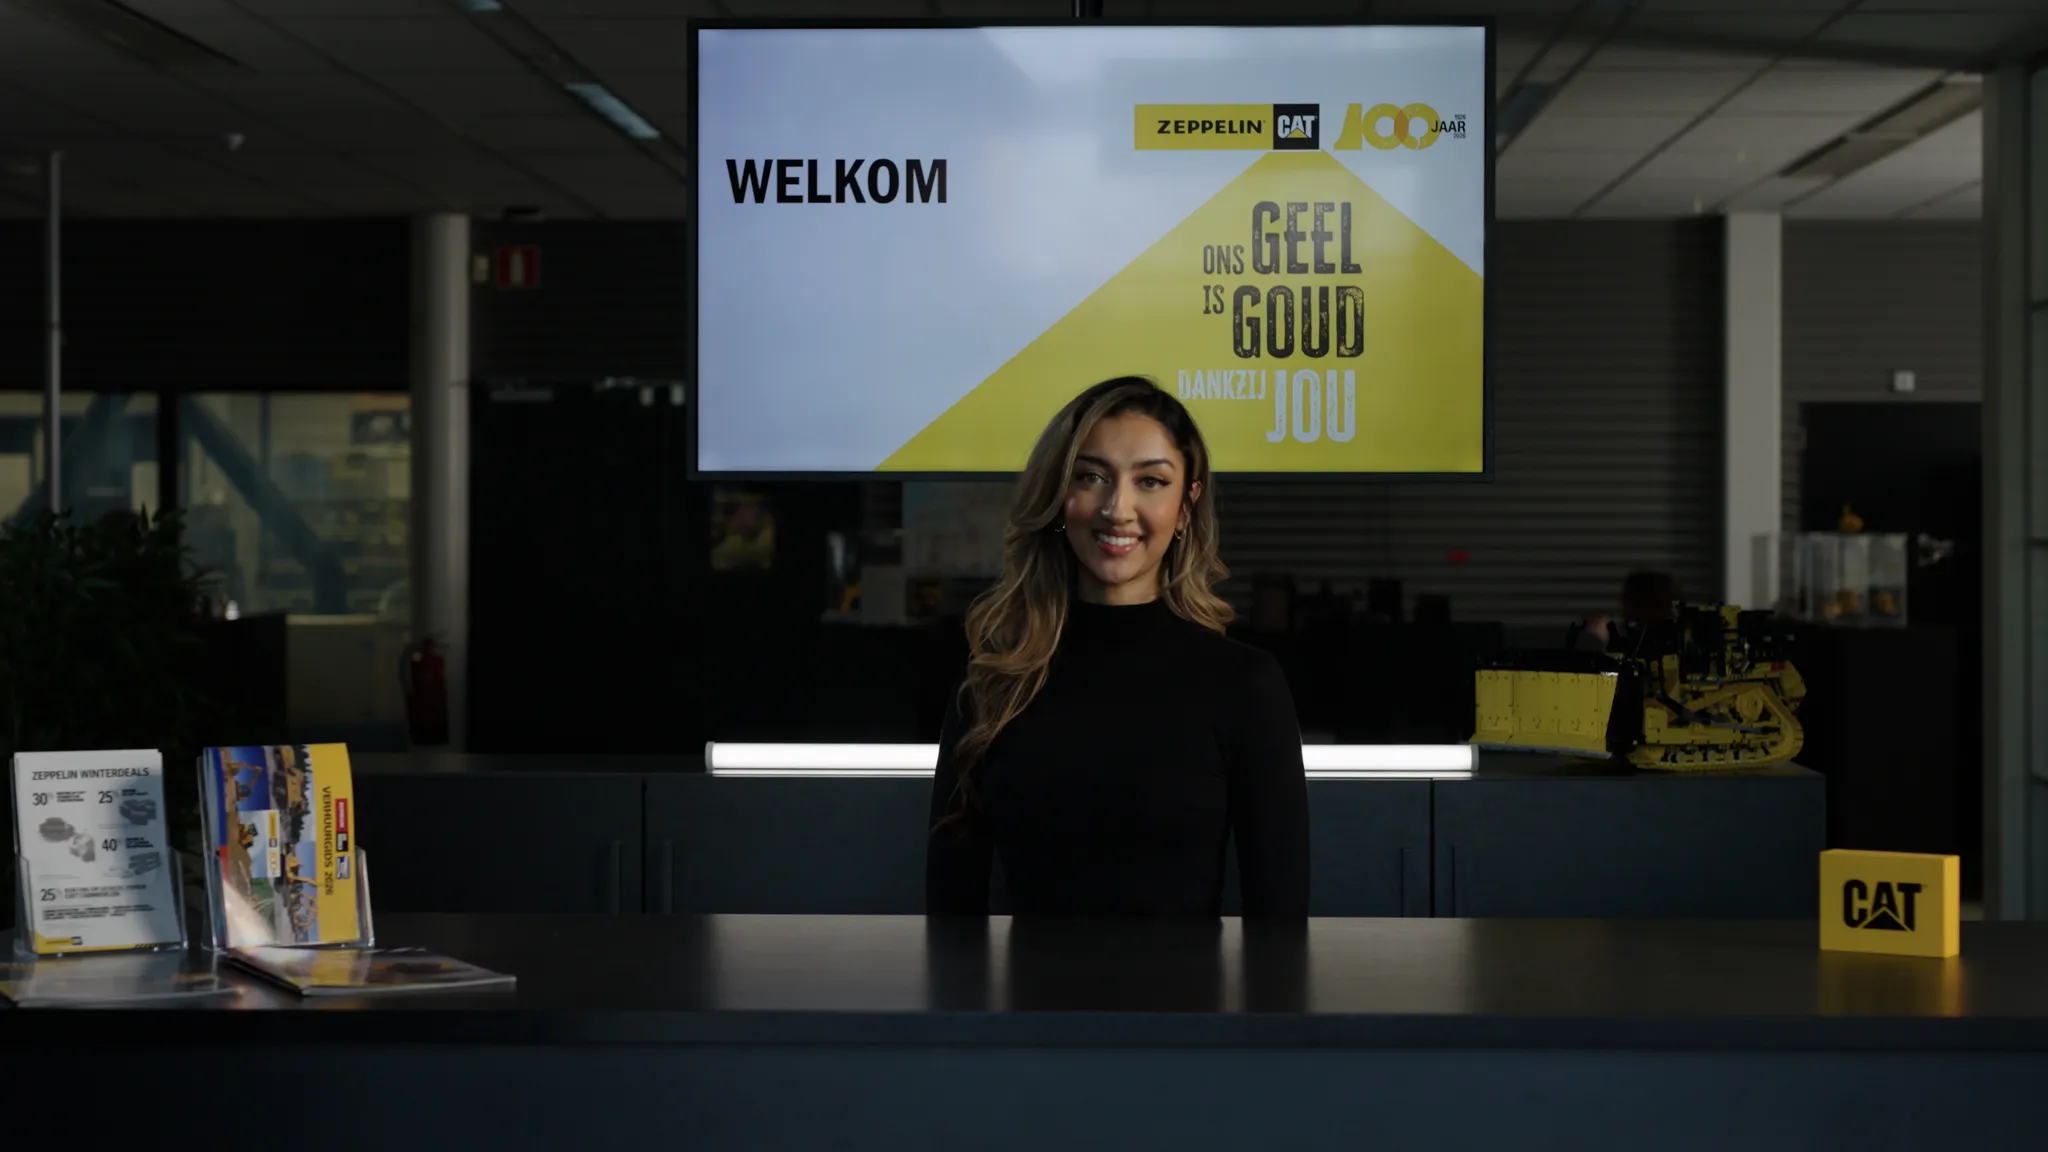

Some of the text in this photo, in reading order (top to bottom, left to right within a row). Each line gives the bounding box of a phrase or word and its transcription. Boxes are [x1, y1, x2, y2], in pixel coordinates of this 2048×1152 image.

[1157, 114, 1316, 139] ZEPPELIN CAT
[1333, 103, 1466, 150] 100 JAAR
[726, 158, 947, 204] WELKOM
[1203, 201, 1362, 275] ONS GEEL
[1203, 285, 1364, 359] IS GOUD
[1178, 369, 1356, 443] DANKZIJ JOU
[32, 767, 149, 781] ZEPPELIN WINTERDEALS
[322, 785, 334, 896] VERHUURGIDS 2026
[1843, 879, 1922, 932] CAT
